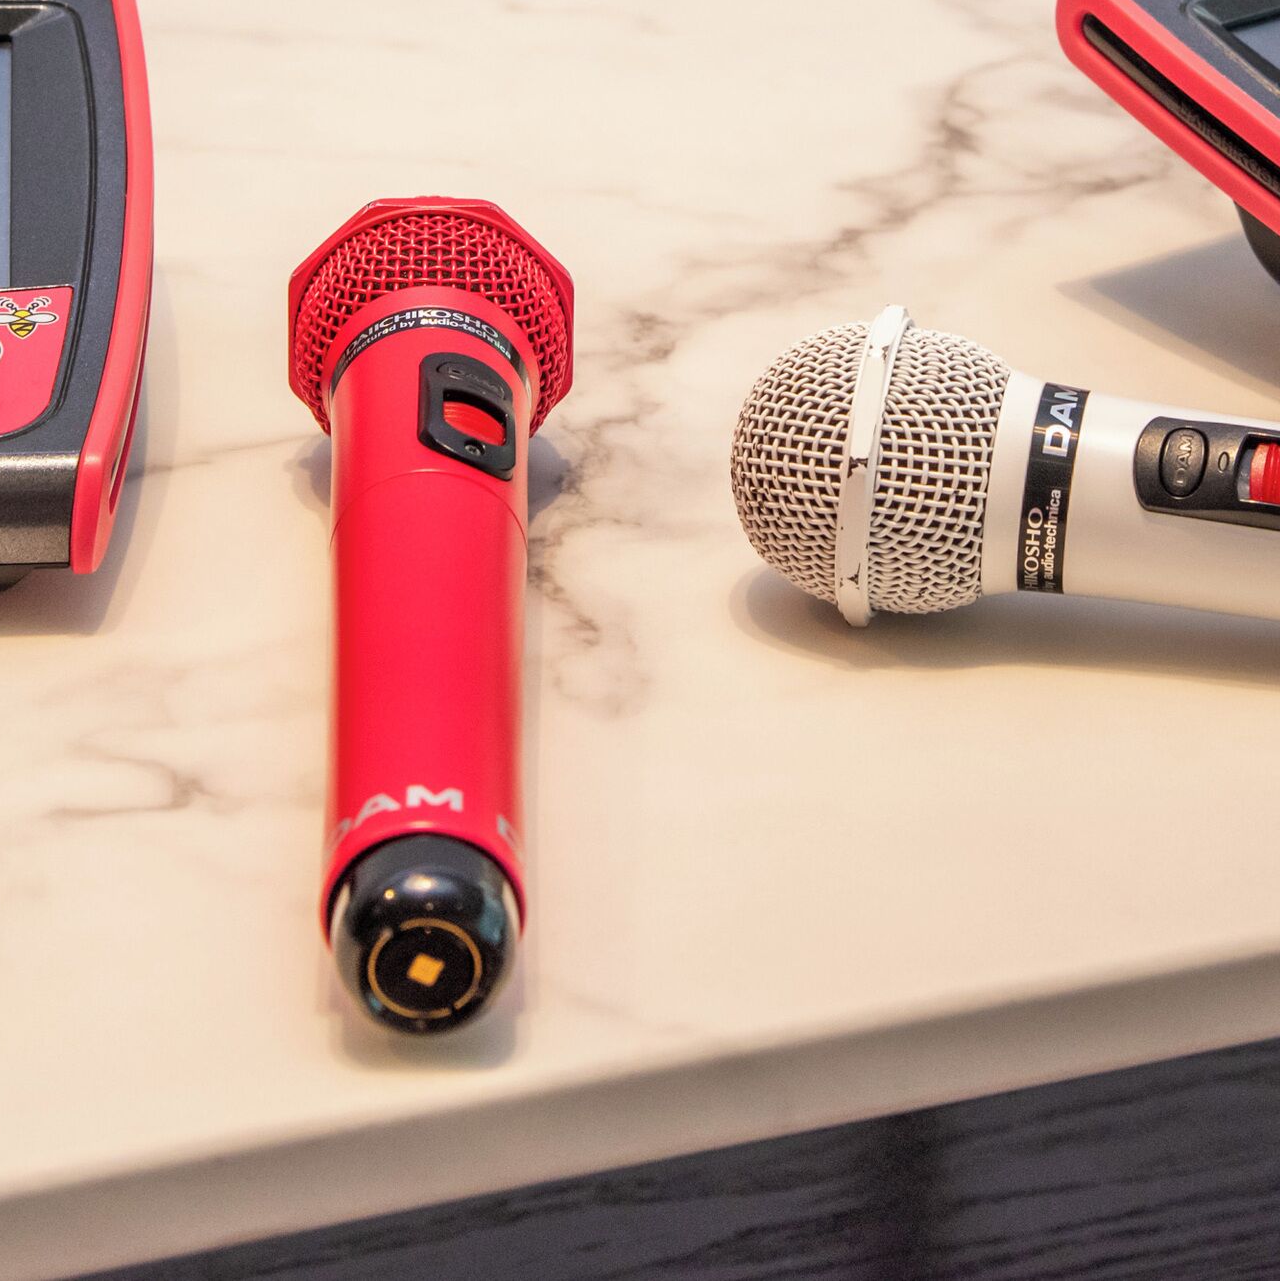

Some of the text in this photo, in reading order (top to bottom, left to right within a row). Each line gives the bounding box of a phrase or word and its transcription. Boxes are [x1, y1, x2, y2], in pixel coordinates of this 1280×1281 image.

[345, 309, 499, 354] DAIICHIKOSHO
[400, 321, 416, 329] by
[420, 318, 512, 361] audio-technica
[1173, 434, 1195, 487] DAM
[1041, 489, 1061, 580] audio-technica
